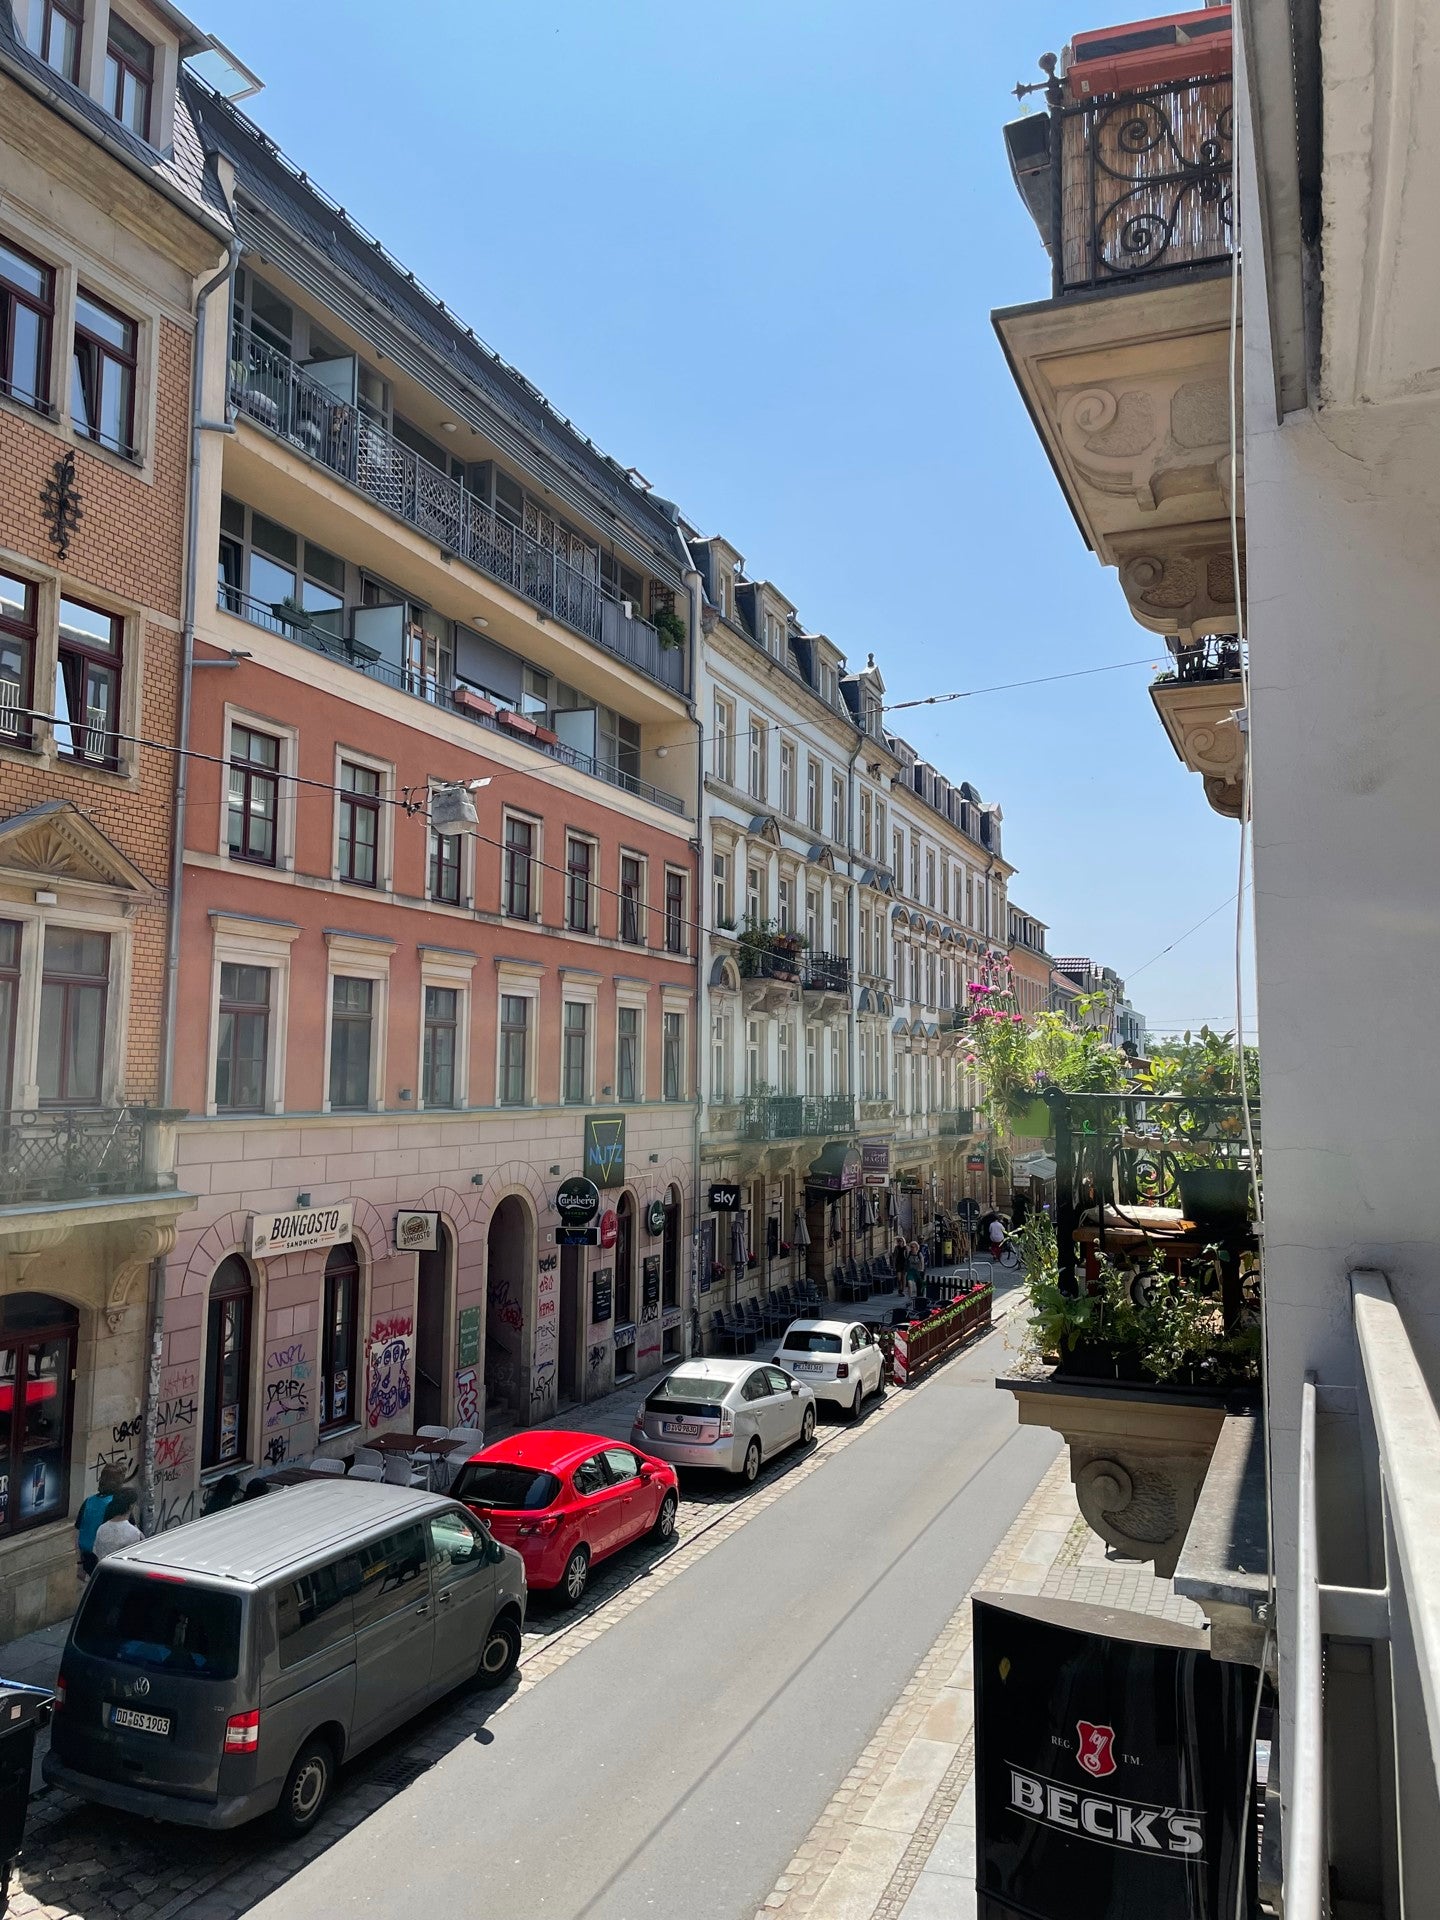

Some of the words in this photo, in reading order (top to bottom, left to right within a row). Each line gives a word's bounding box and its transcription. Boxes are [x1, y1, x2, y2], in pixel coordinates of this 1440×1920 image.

[589, 1144, 623, 1166] NUTZ
[558, 1194, 596, 1208] Carlsberg
[713, 1190, 736, 1206] sky
[271, 1210, 340, 1241] BONGOSTO
[286, 1237, 319, 1249] SANDWICH
[403, 1231, 431, 1246] BONGOSTO
[116, 1709, 128, 1724] DD
[132, 1713, 145, 1728] GS
[146, 1716, 170, 1733] 1903
[1051, 1734, 1074, 1750] REG.
[1010, 1769, 1204, 1855] BECK'S
